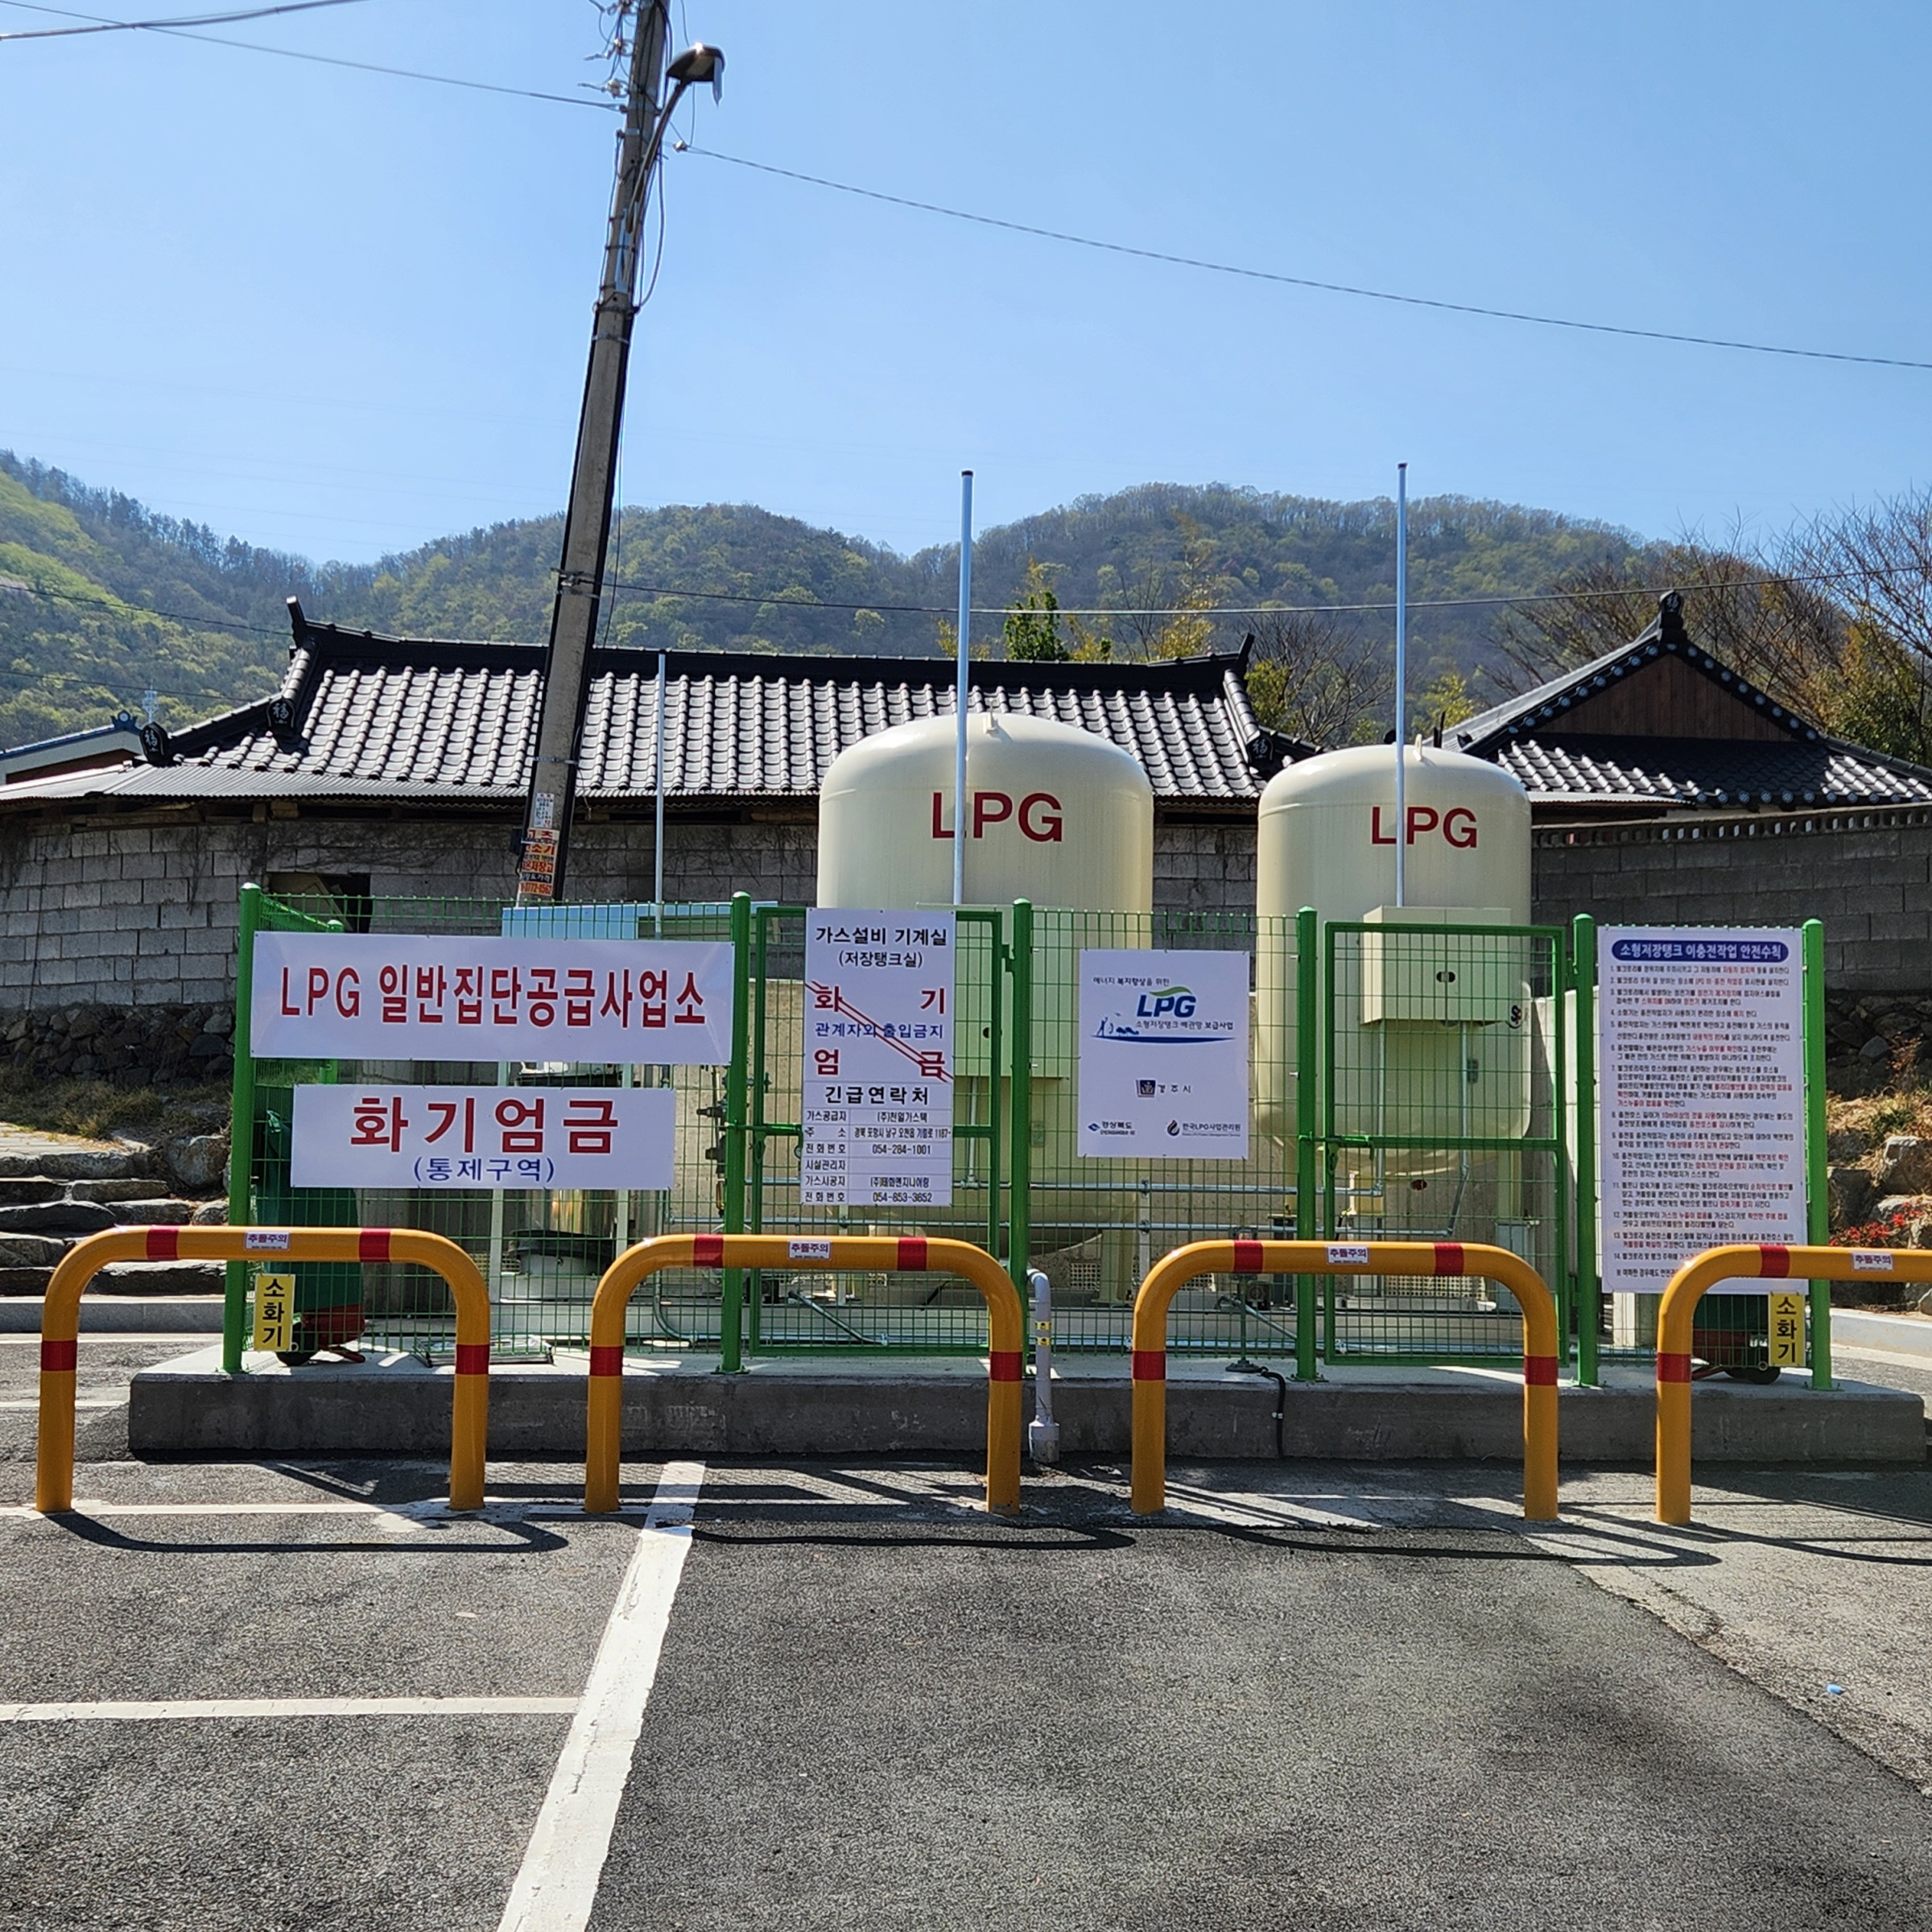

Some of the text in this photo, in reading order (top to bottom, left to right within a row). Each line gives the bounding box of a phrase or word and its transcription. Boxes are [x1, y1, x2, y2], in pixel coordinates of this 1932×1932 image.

[931, 791, 1063, 842] LPG
[1372, 807, 1478, 848] LPG
[815, 926, 947, 946] 가스설비 기계실
[839, 950, 923, 968] (저장탱크실)
[1620, 943, 1683, 958] 소형저장탱크
[1740, 944, 1781, 960] 안전수칙
[281, 964, 706, 1029] LPG 일반집단공급사업소
[1137, 995, 1197, 1018] LPG
[825, 1086, 928, 1105] 긴급연락처
[350, 1096, 618, 1154] 화기엄금
[807, 1111, 846, 1121] 가스공급자
[806, 1143, 931, 1154] 전화번호 054-284-1001
[414, 1157, 555, 1183] (통제구역)
[805, 1160, 846, 1170] 시설관리자
[805, 1176, 845, 1187] 가스시공자
[805, 1191, 845, 1202] 전화번호
[248, 1233, 287, 1243] 추돌주의
[262, 1278, 285, 1347] 소화기
[1776, 1297, 1797, 1362] 소화기
